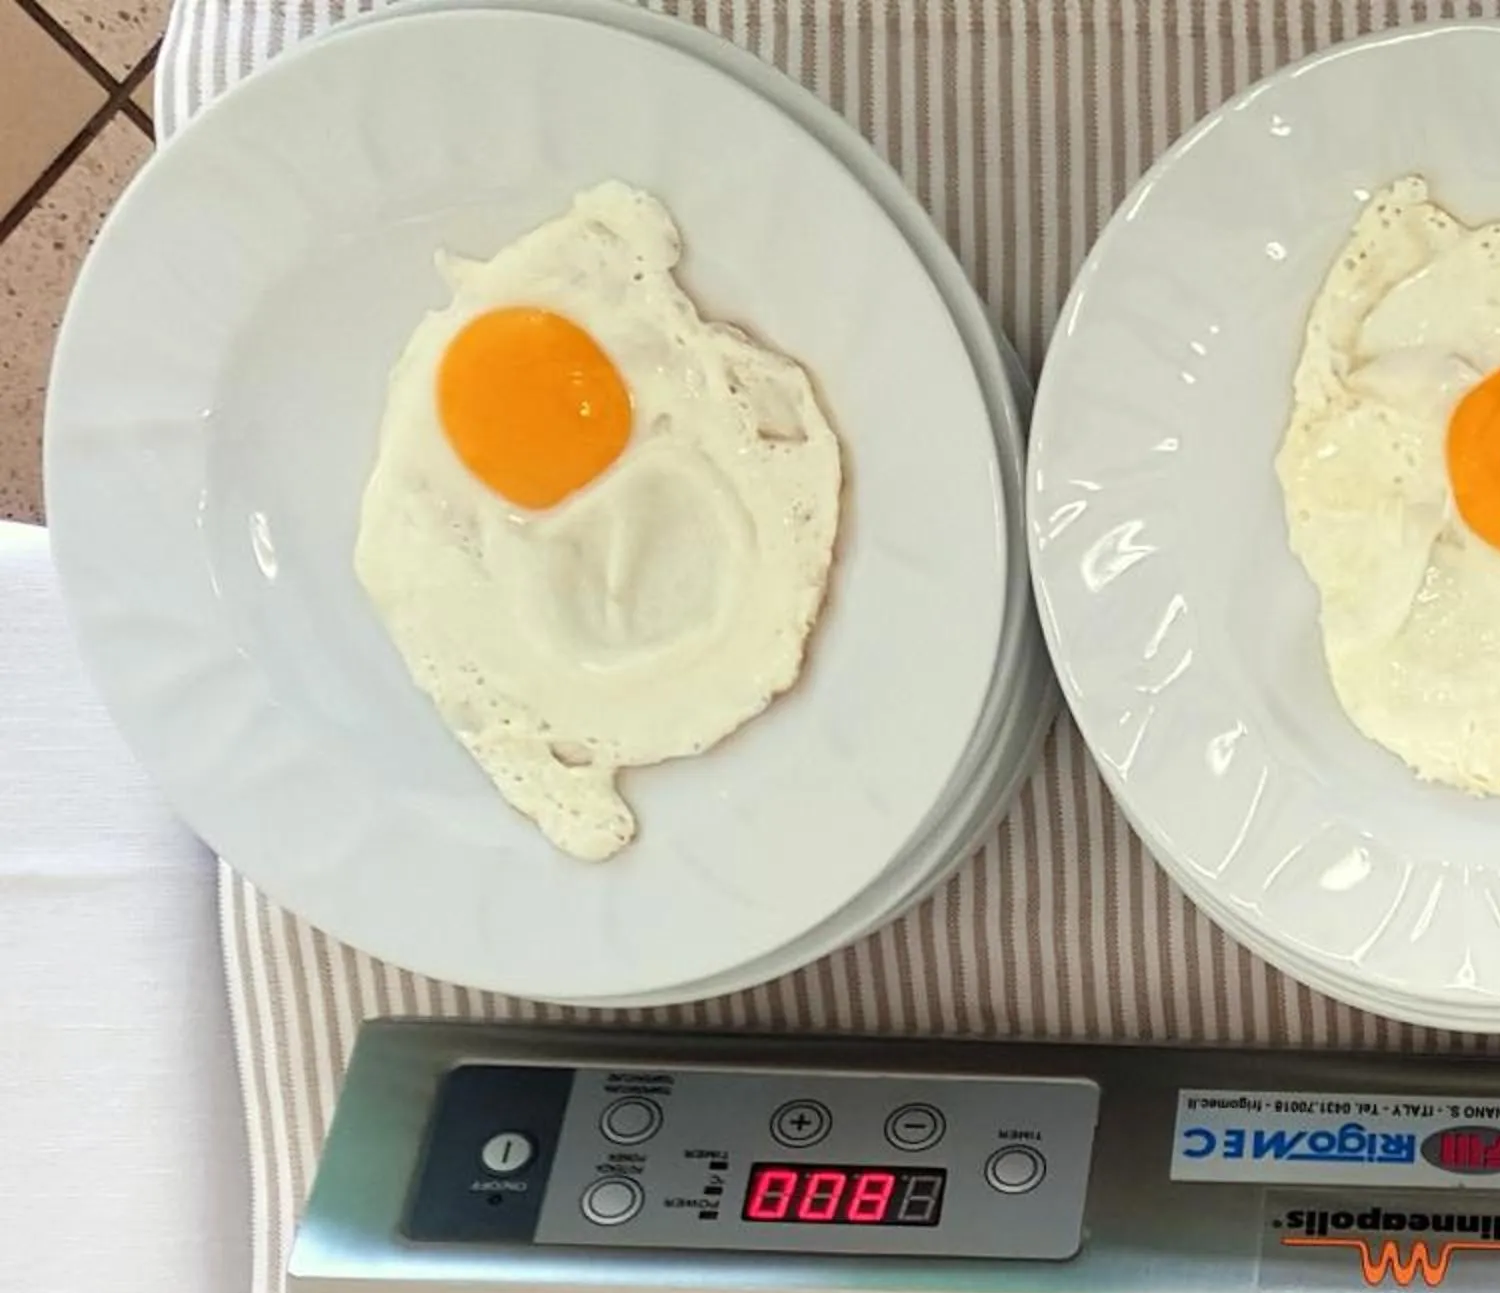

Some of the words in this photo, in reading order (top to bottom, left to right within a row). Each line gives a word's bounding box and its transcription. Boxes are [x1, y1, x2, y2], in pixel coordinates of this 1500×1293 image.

[1187, 1097, 1263, 1113] frigomec.it
[1275, 1100, 1352, 1115] 0431.70018
[1356, 1103, 1379, 1116] Tel.
[1392, 1104, 1434, 1117] ITALY
[998, 1129, 1042, 1141] TIMER
[685, 1150, 729, 1159] TIMER
[664, 1198, 720, 1208] POWER
